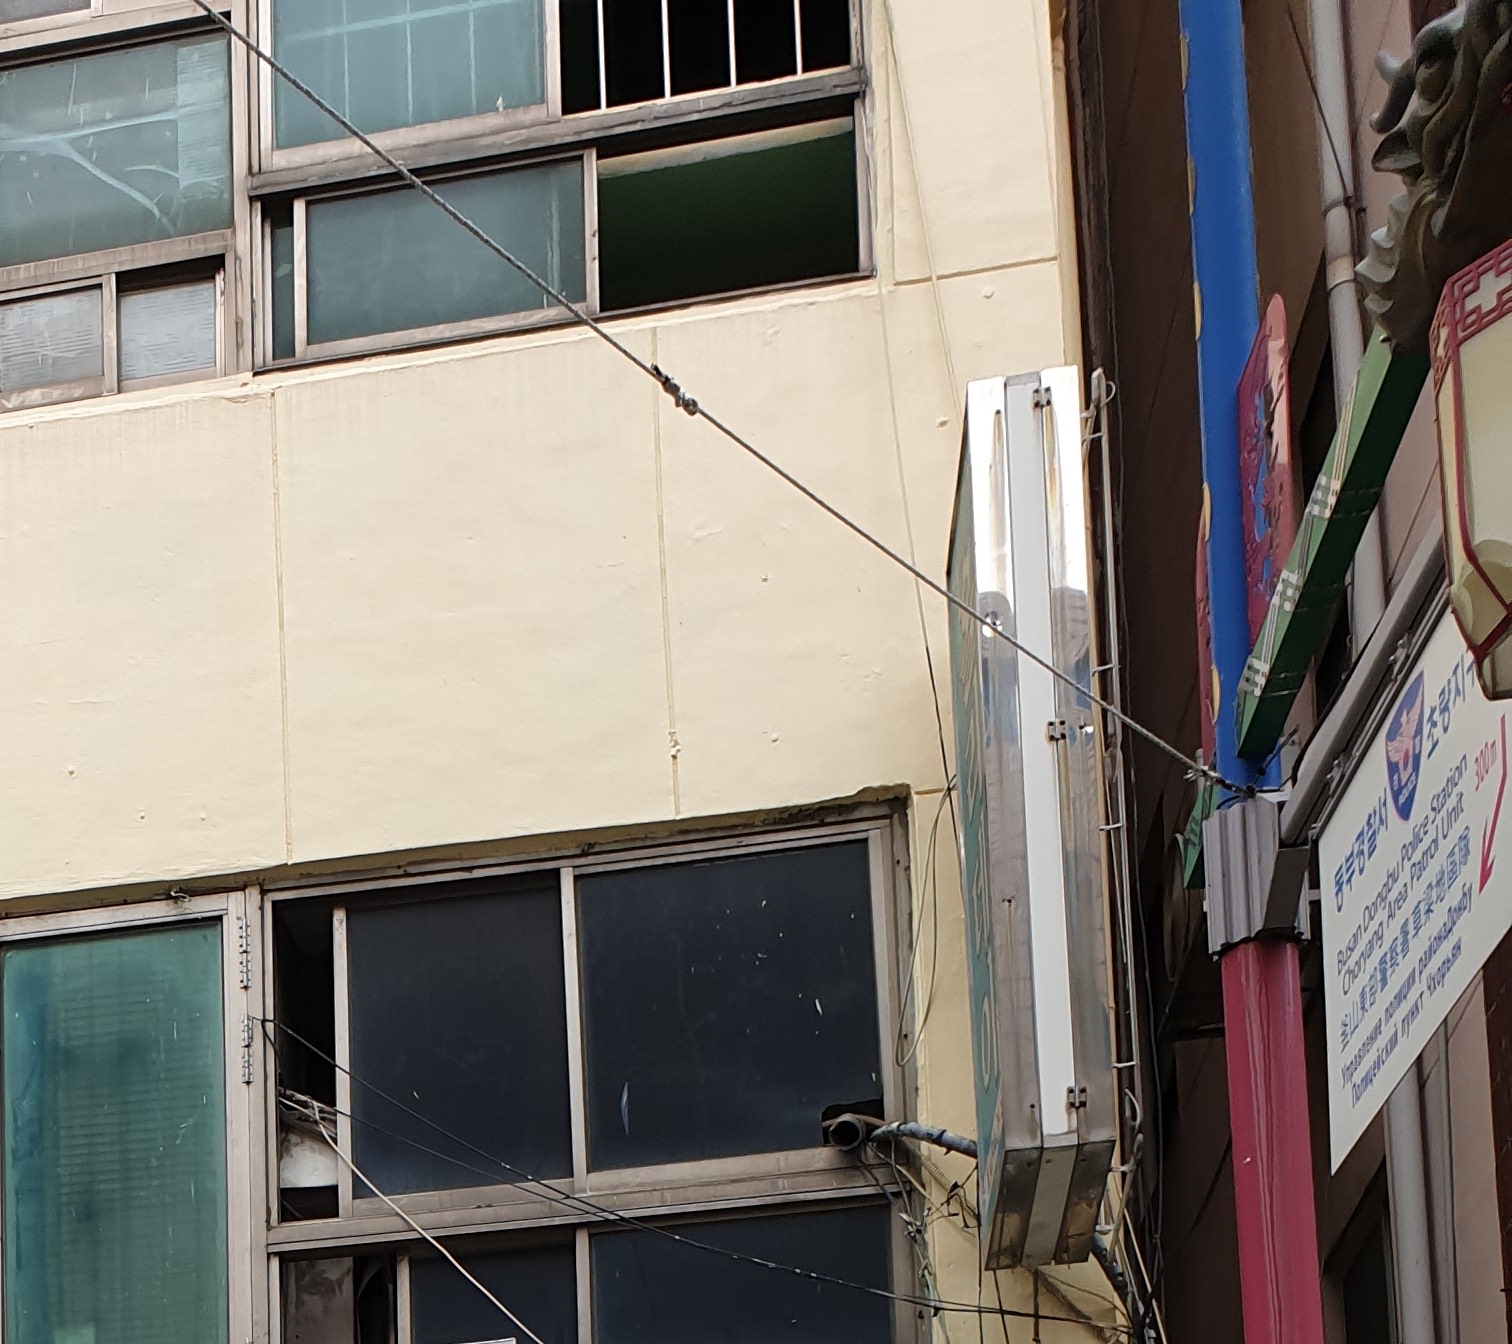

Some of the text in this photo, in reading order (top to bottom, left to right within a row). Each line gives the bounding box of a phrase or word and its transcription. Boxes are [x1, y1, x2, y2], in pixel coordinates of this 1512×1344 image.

[1338, 753, 1467, 977] Busan Dongbu Police Station
[1474, 739, 1497, 792] 300m
[1342, 790, 1464, 996] Choryang Area Patrol Unit
